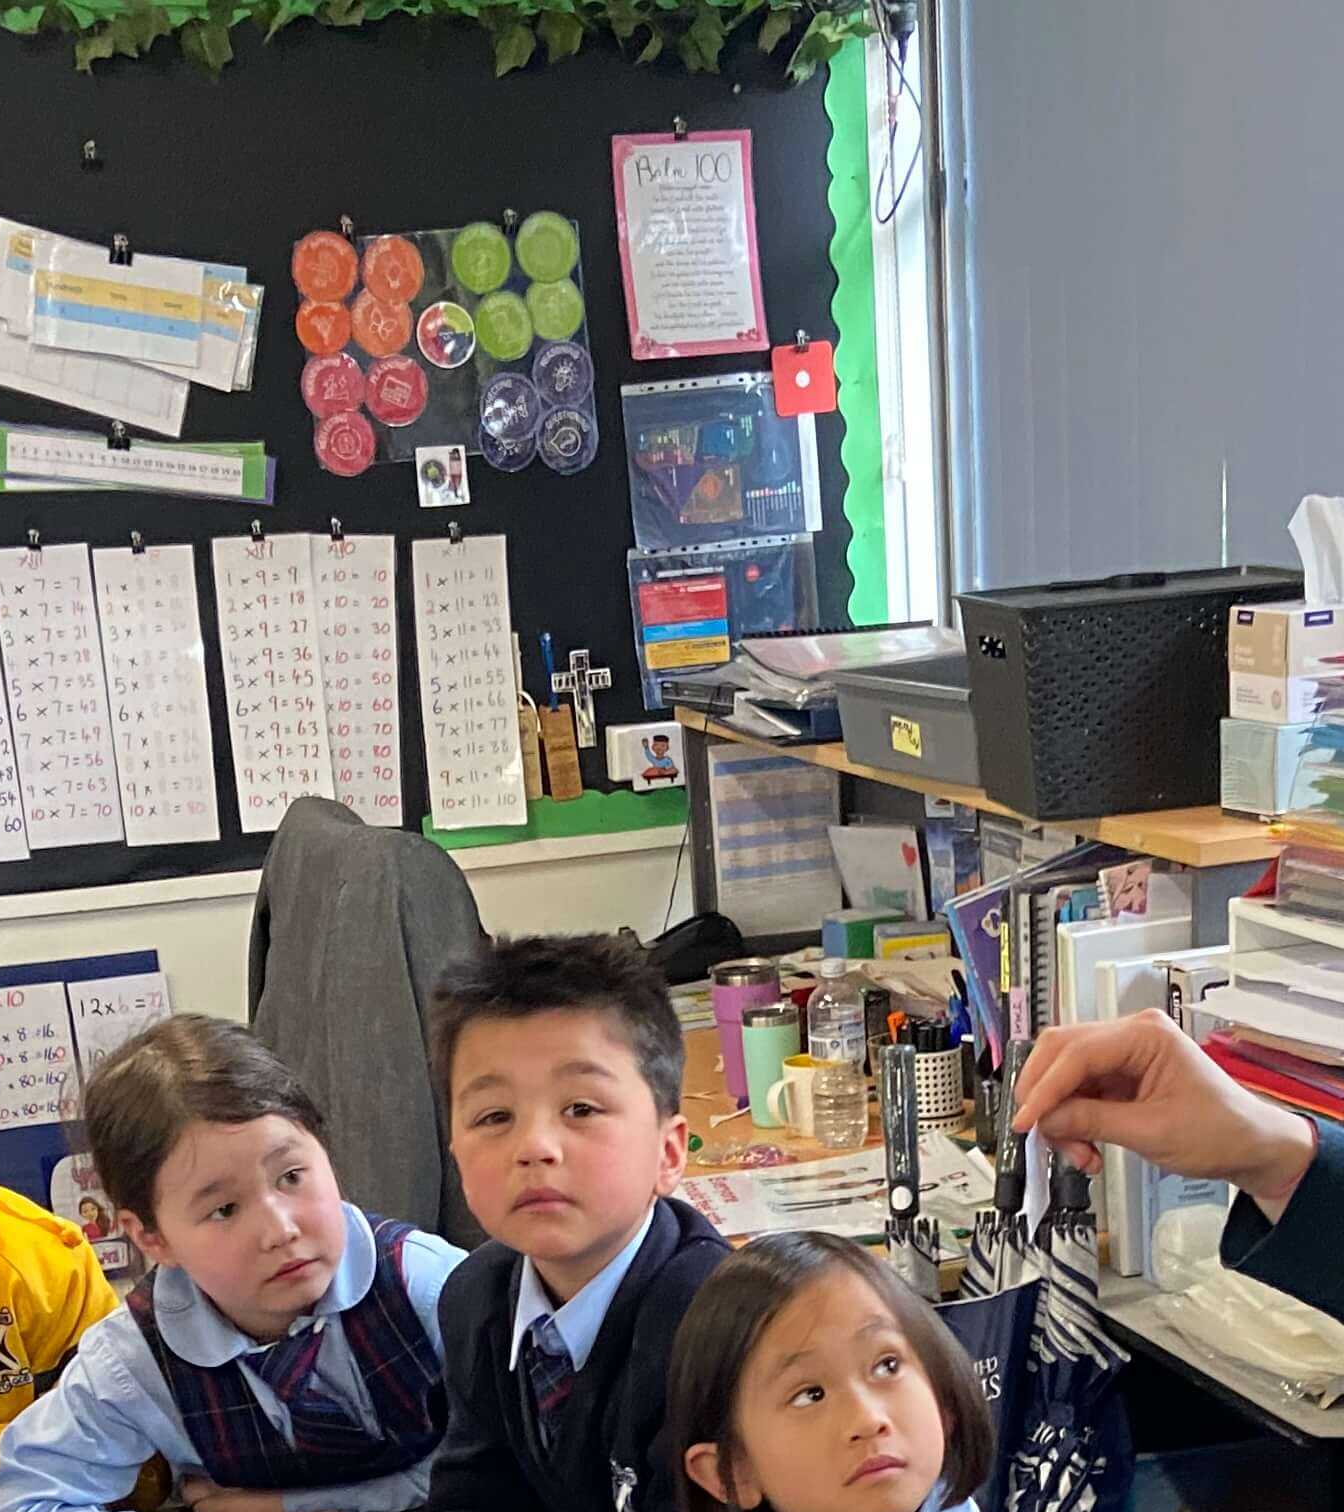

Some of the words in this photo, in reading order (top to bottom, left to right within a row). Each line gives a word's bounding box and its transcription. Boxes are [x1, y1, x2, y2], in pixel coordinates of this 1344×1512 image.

[695, 152, 732, 183] 100
[235, 699, 249, 717] 6
[294, 696, 316, 712] 54
[17, 1027, 27, 1042] 8
